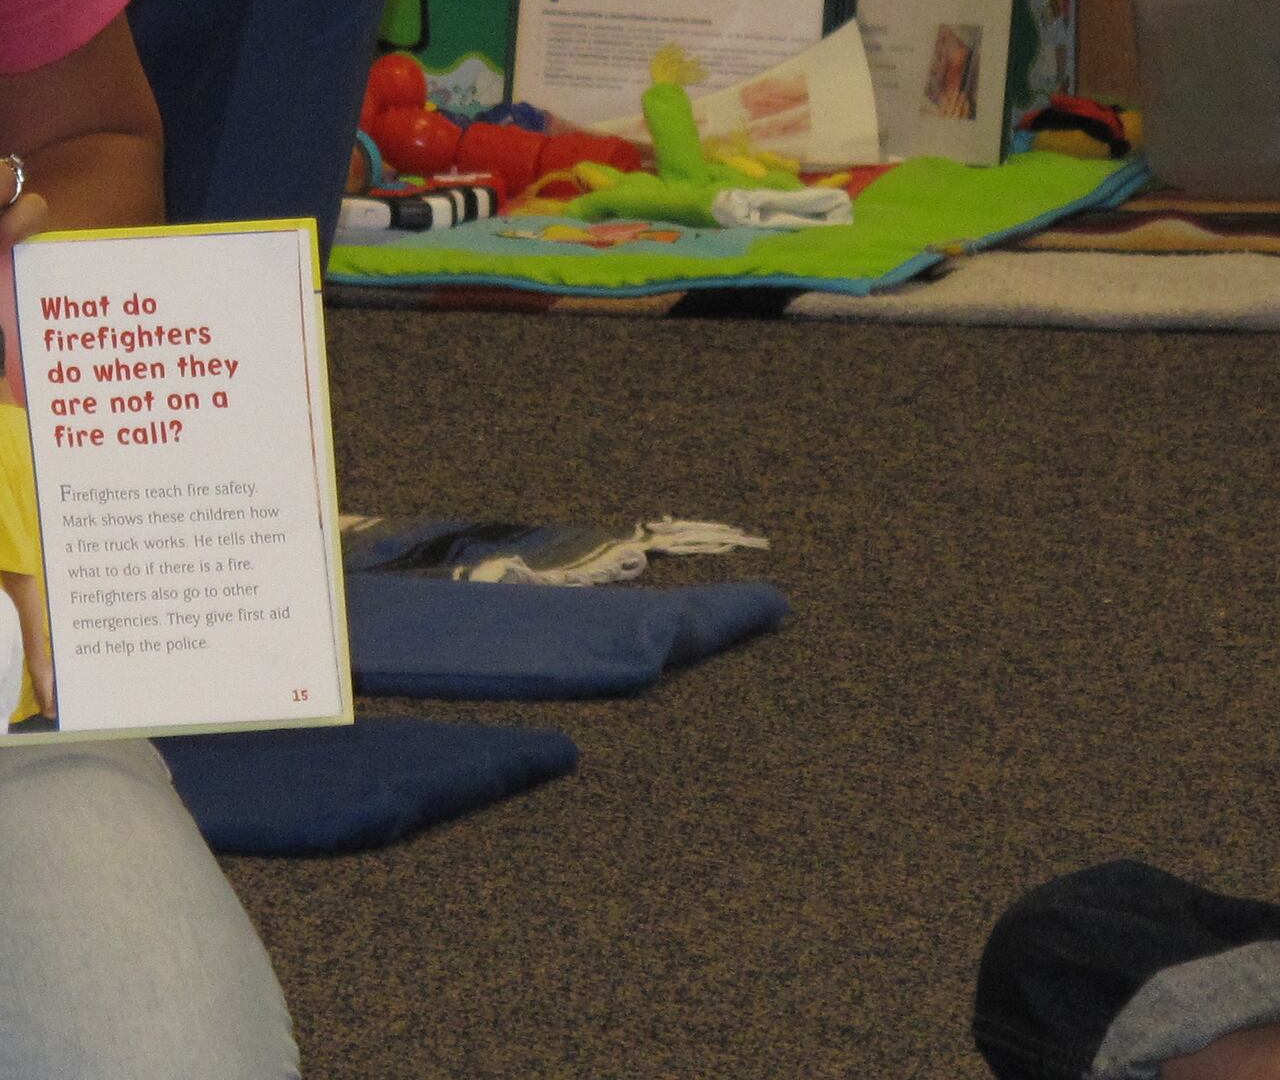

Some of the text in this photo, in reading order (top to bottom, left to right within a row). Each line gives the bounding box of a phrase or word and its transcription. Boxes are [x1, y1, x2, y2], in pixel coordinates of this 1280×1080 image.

[40, 293, 157, 321] What do
[44, 325, 212, 353] firefighters
[48, 354, 239, 384] do when they
[51, 390, 229, 416] are not on a
[54, 420, 183, 448] fire call?
[60, 481, 259, 504] Firefighters teach fire safety.
[62, 506, 280, 528] Mark shows these children how
[65, 532, 287, 553] a fire truck works. He tells them
[68, 558, 254, 579] what to do if there is a fire.
[70, 583, 259, 606] Firefighters also go to other
[72, 606, 291, 631] emergencies. They give first aid
[75, 637, 210, 656] and help the police.
[292, 689, 309, 702] 15
